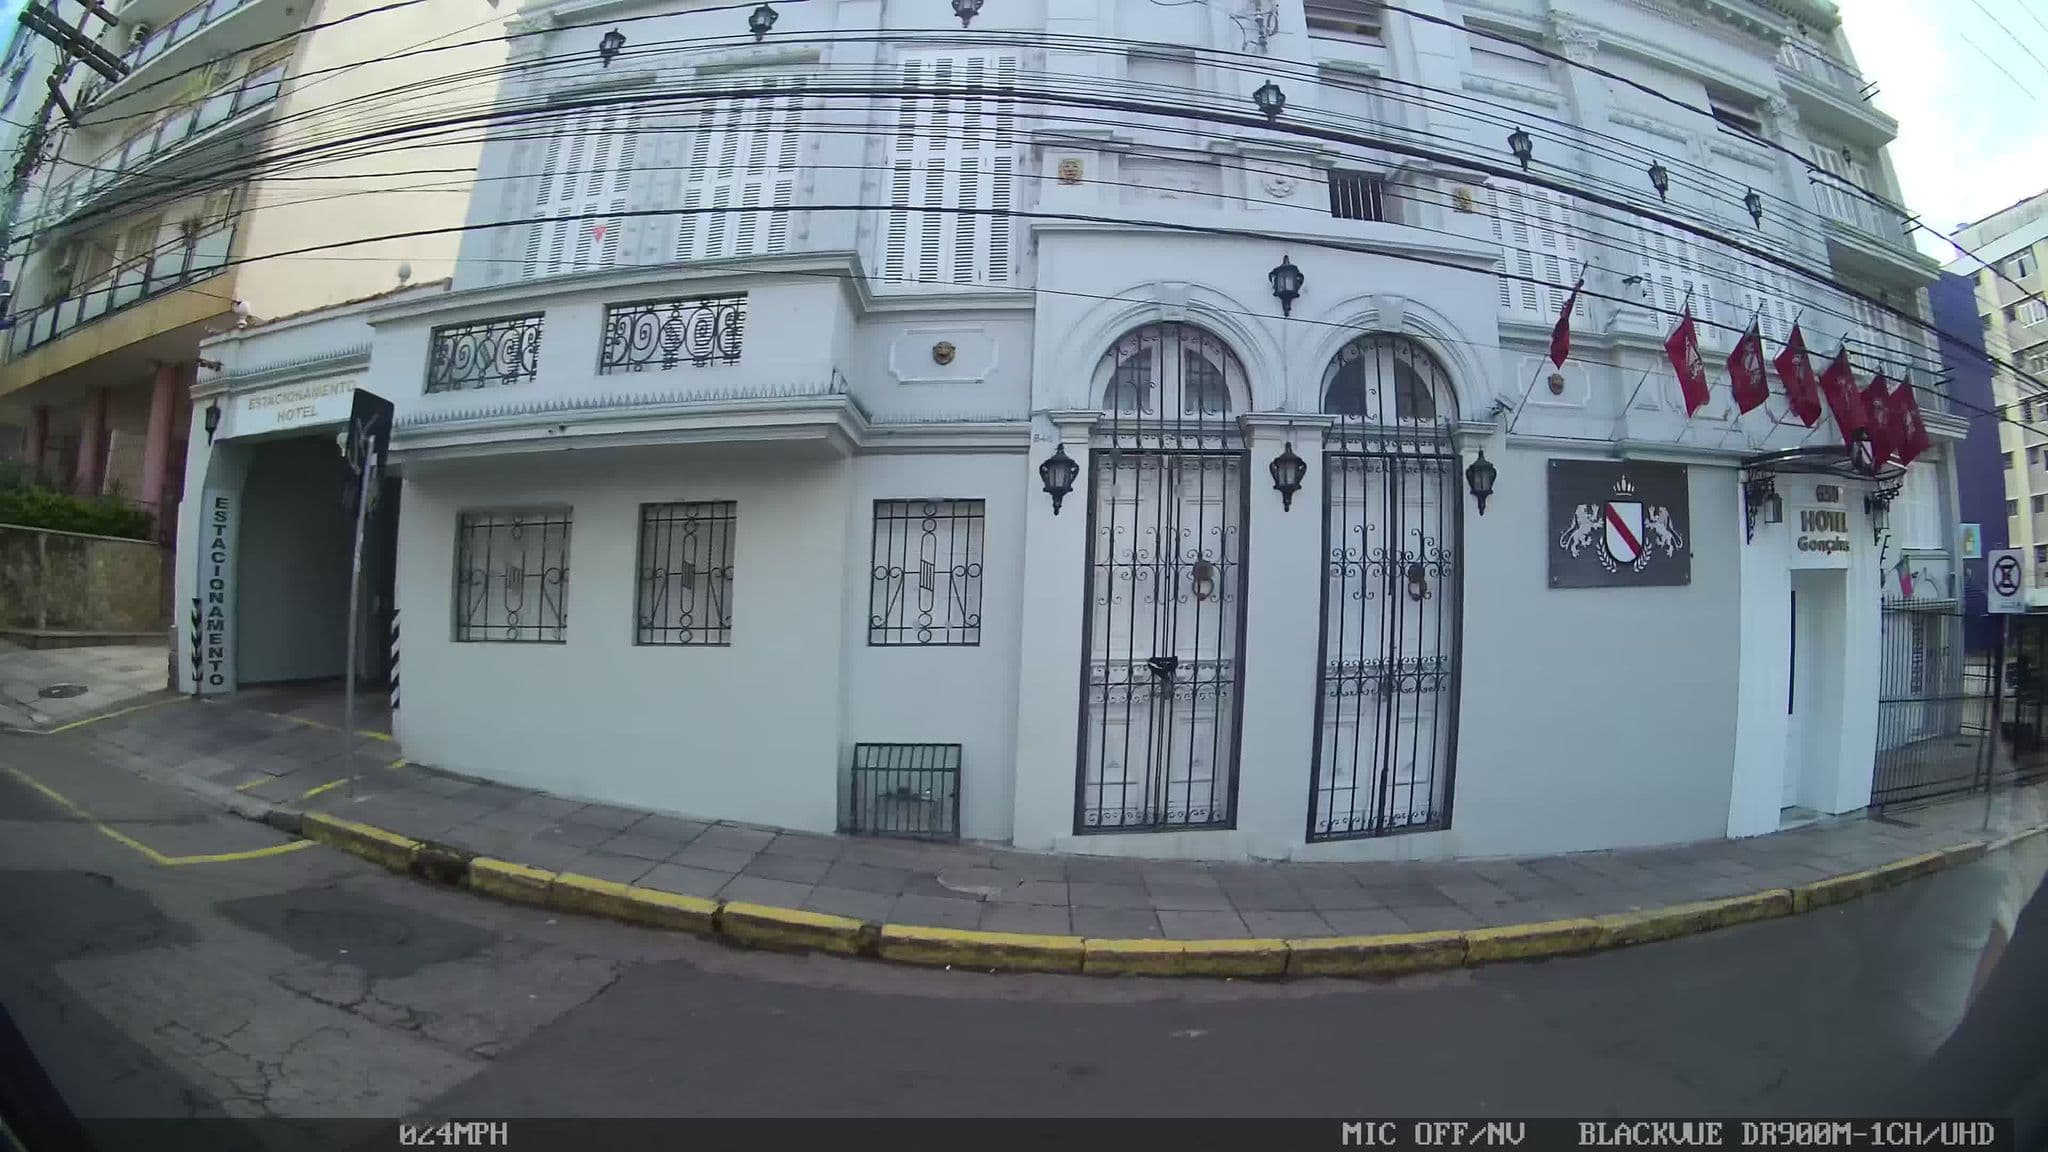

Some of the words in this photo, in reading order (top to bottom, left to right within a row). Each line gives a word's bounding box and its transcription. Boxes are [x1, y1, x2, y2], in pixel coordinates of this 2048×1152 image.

[248, 381, 356, 409] ESTACIONAMENTO
[277, 405, 317, 422] HOTEL
[1800, 510, 1848, 533] HOTEL
[207, 497, 230, 686] ESTACIONAMENTO
